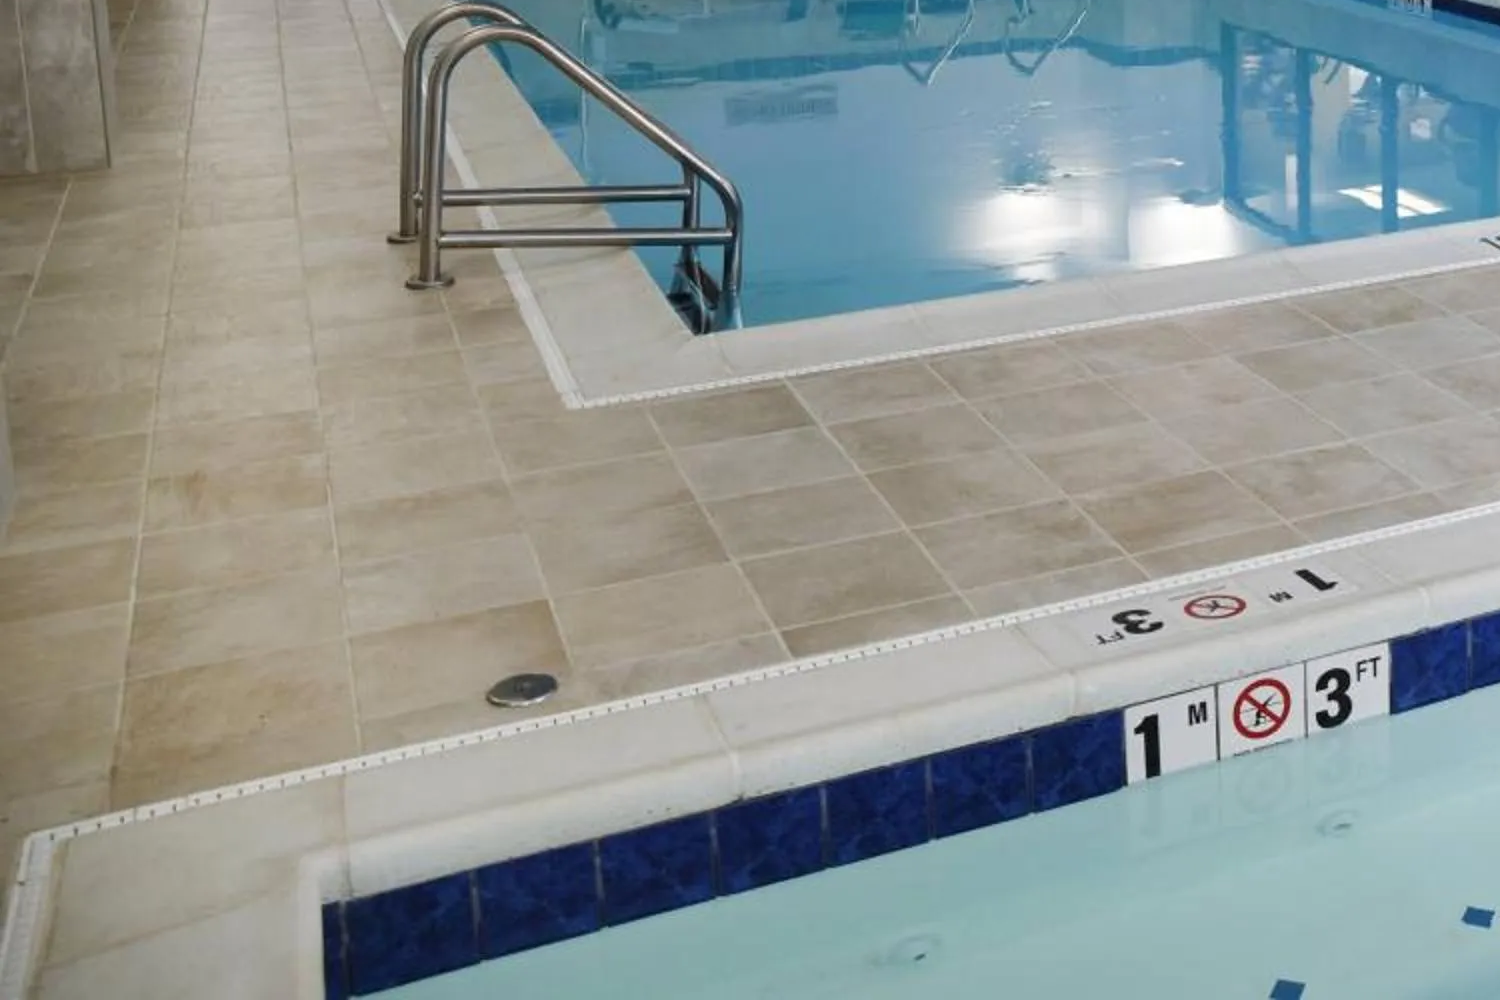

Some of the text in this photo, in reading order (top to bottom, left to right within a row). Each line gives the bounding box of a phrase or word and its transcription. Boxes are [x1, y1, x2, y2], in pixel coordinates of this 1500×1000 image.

[1294, 568, 1339, 592] 1
[1111, 609, 1164, 634] 3
[1133, 656, 1382, 779] 1 M 3 FT
